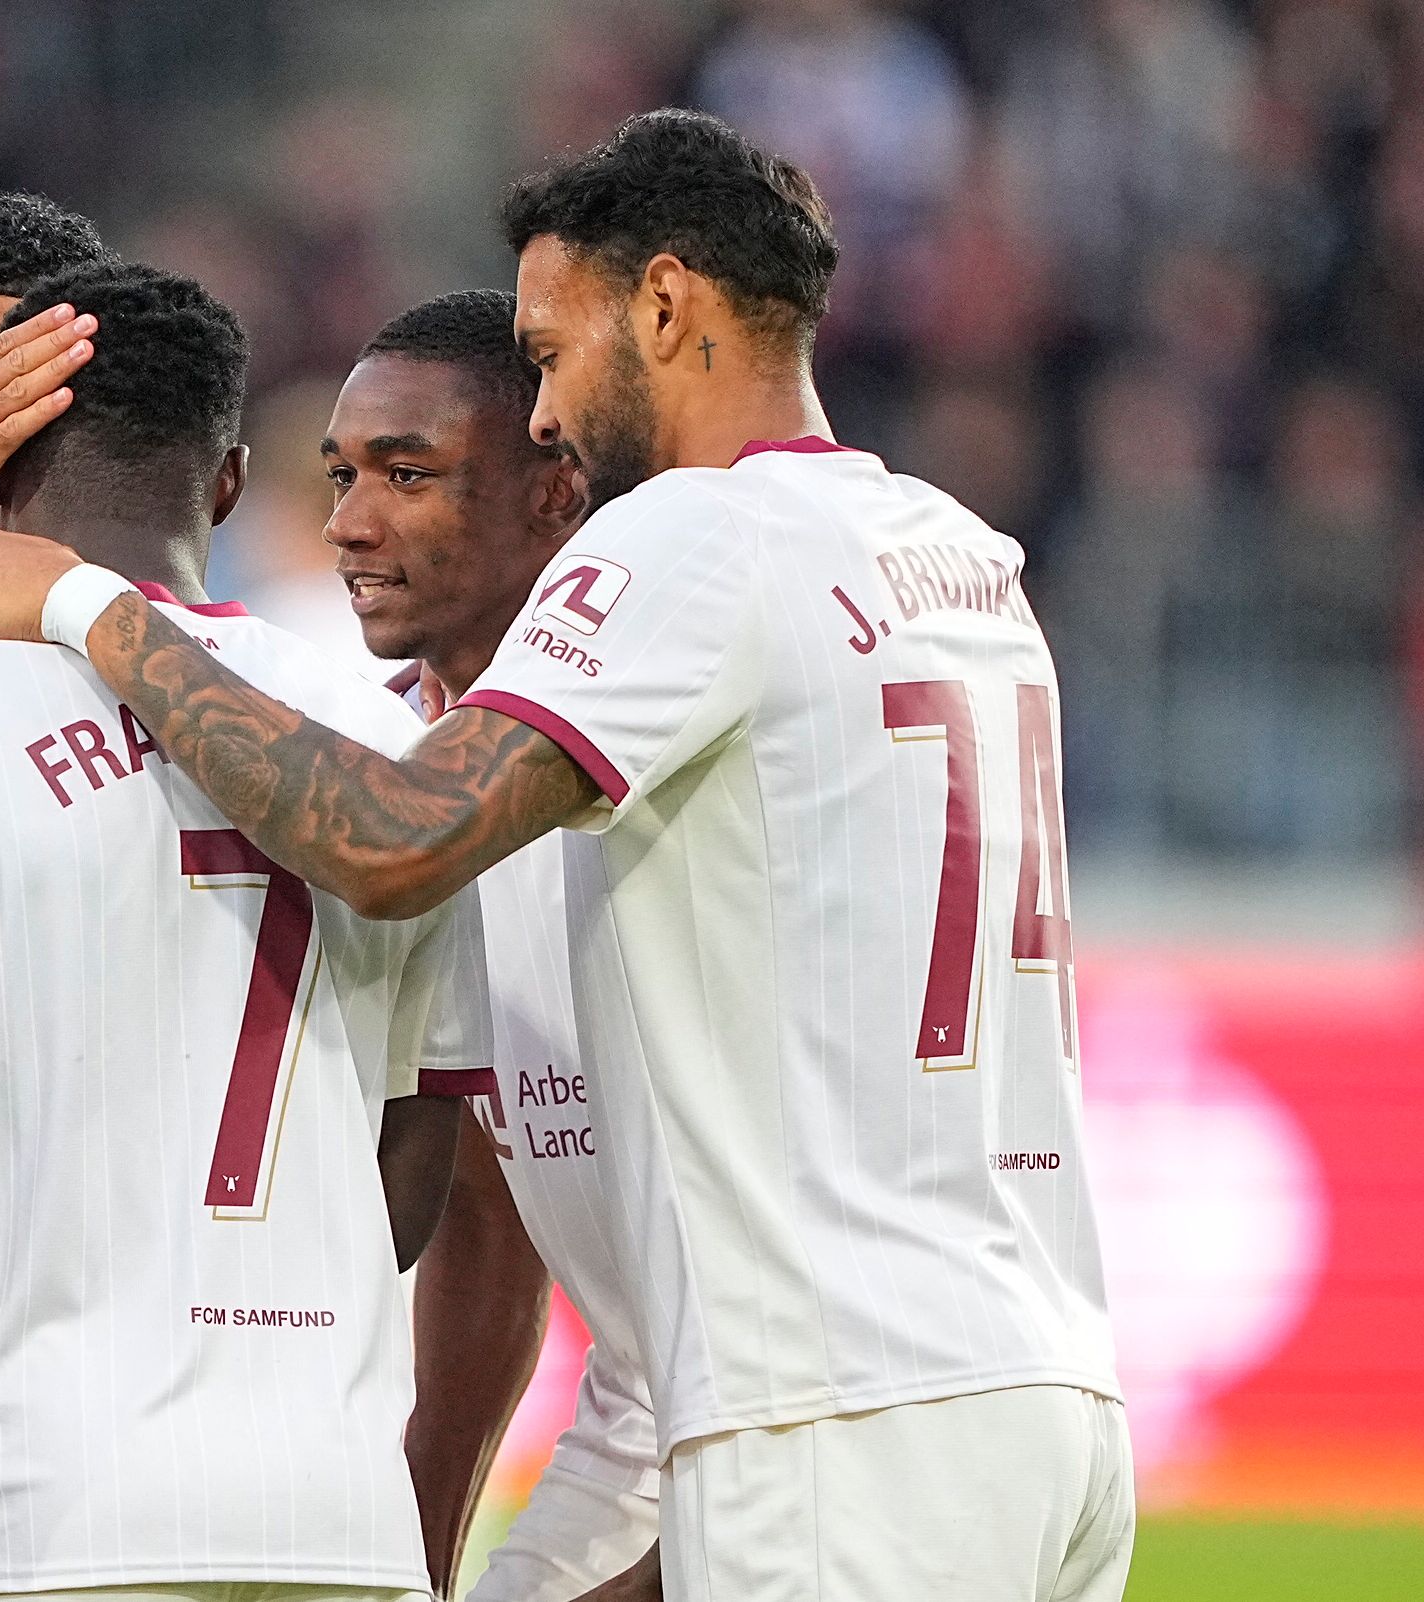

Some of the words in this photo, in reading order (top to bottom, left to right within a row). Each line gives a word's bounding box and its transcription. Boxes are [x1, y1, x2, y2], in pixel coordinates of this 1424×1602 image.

[830, 584, 892, 655] J.
[520, 625, 603, 678] inans
[881, 679, 1076, 1074] 74
[179, 829, 323, 1222] 7
[997, 1152, 1061, 1171] SAMFUND
[190, 1307, 226, 1326] FCM
[232, 1308, 336, 1328] SAMFUND
